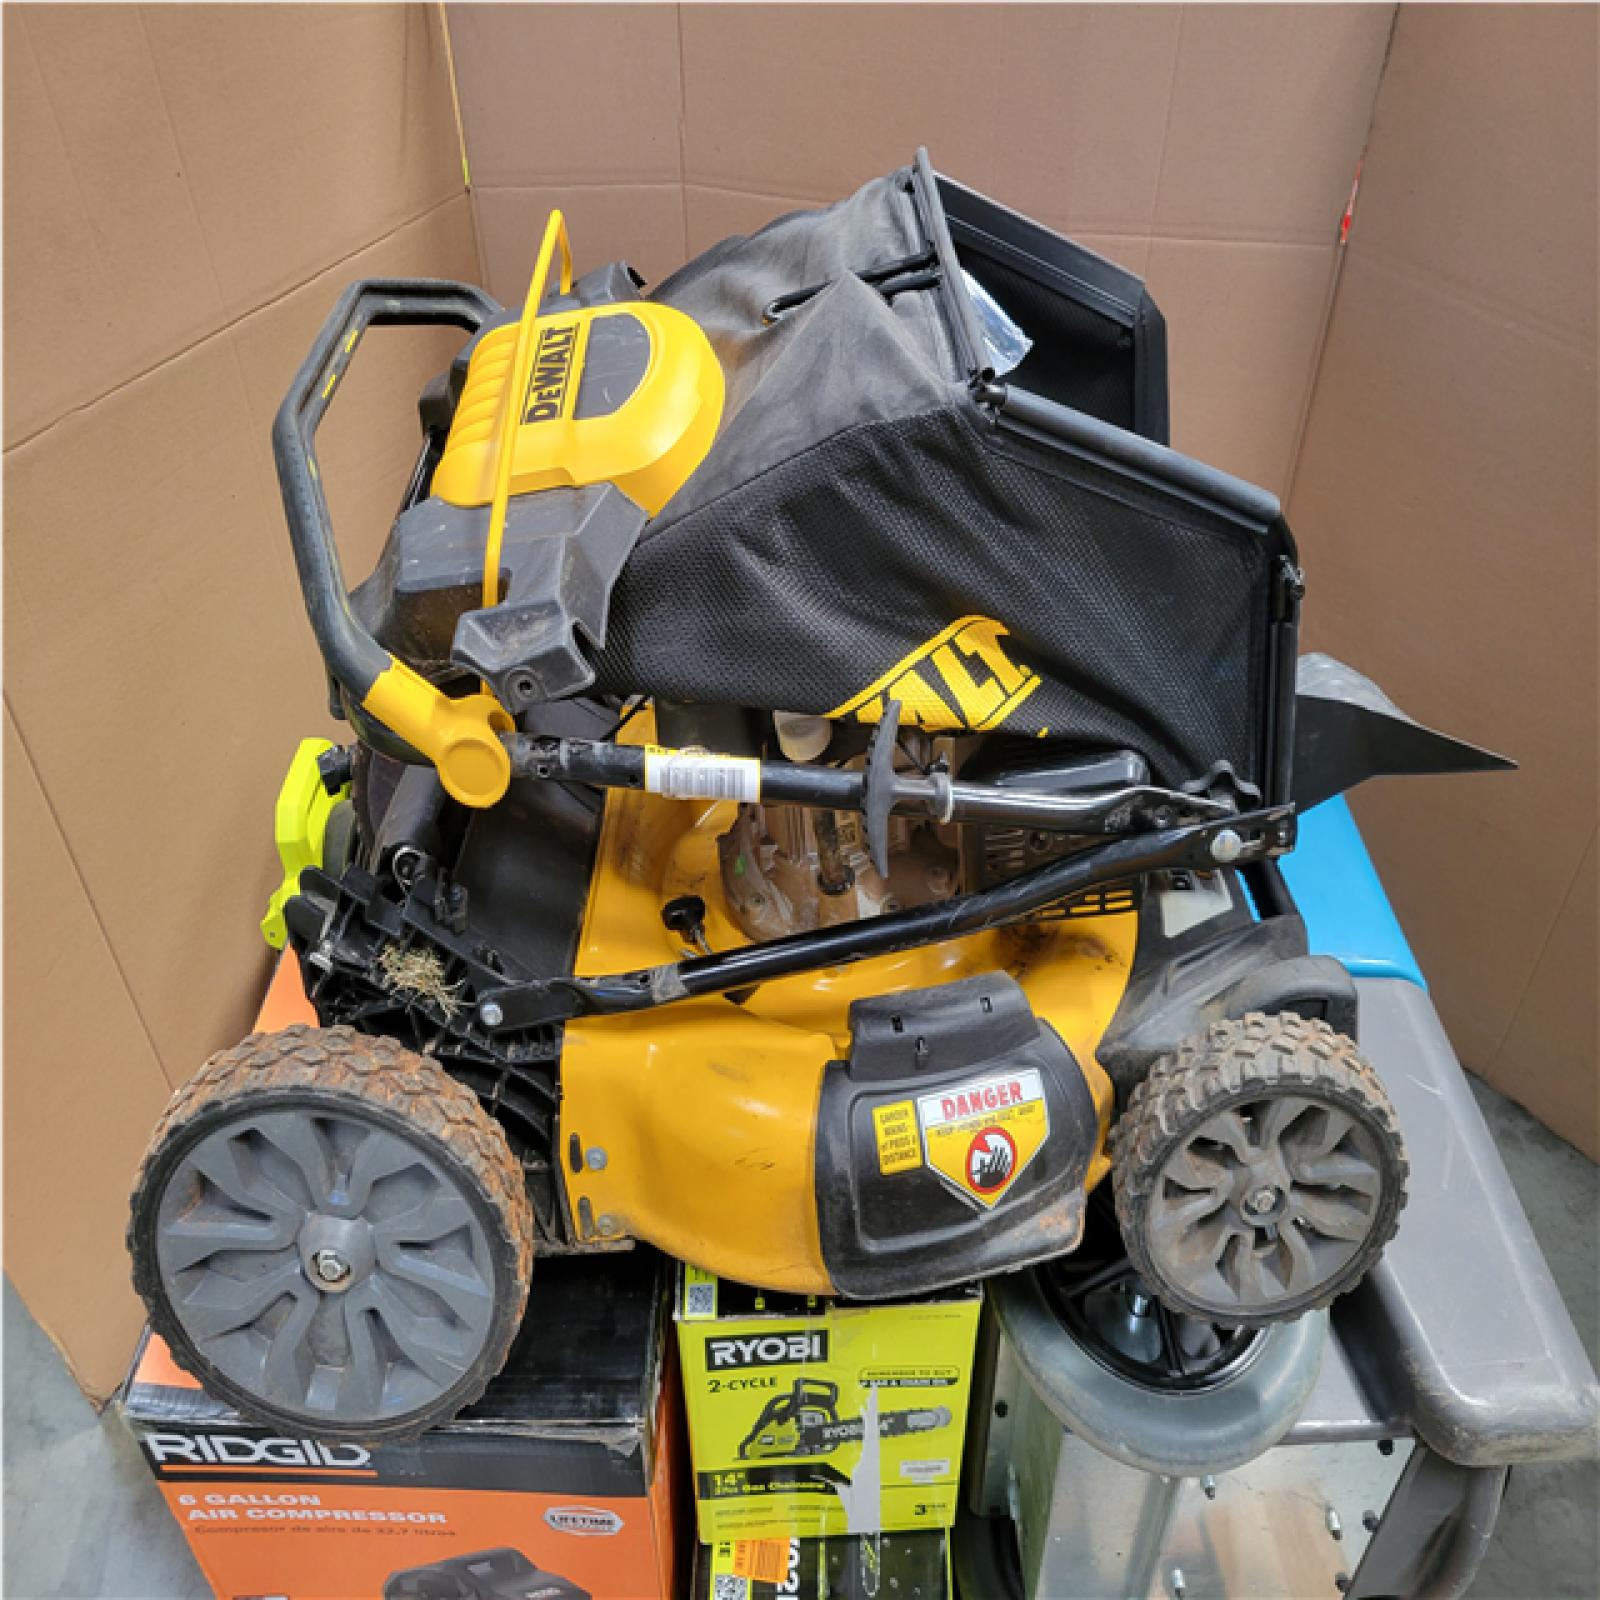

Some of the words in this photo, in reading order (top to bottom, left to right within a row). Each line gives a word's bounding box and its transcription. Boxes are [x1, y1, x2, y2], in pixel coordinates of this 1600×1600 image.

[942, 1081, 1023, 1121] DANGER
[710, 1334, 820, 1366] RYOBI
[707, 1376, 777, 1393] 2-CYCLE
[145, 1434, 371, 1466] RIDGID
[204, 1494, 321, 1506] GALLON
[189, 1509, 239, 1521] AIR
[246, 1509, 448, 1524] COMPRESSOR
[914, 1504, 927, 1516] 3
[548, 1514, 617, 1526] LIFETIME
